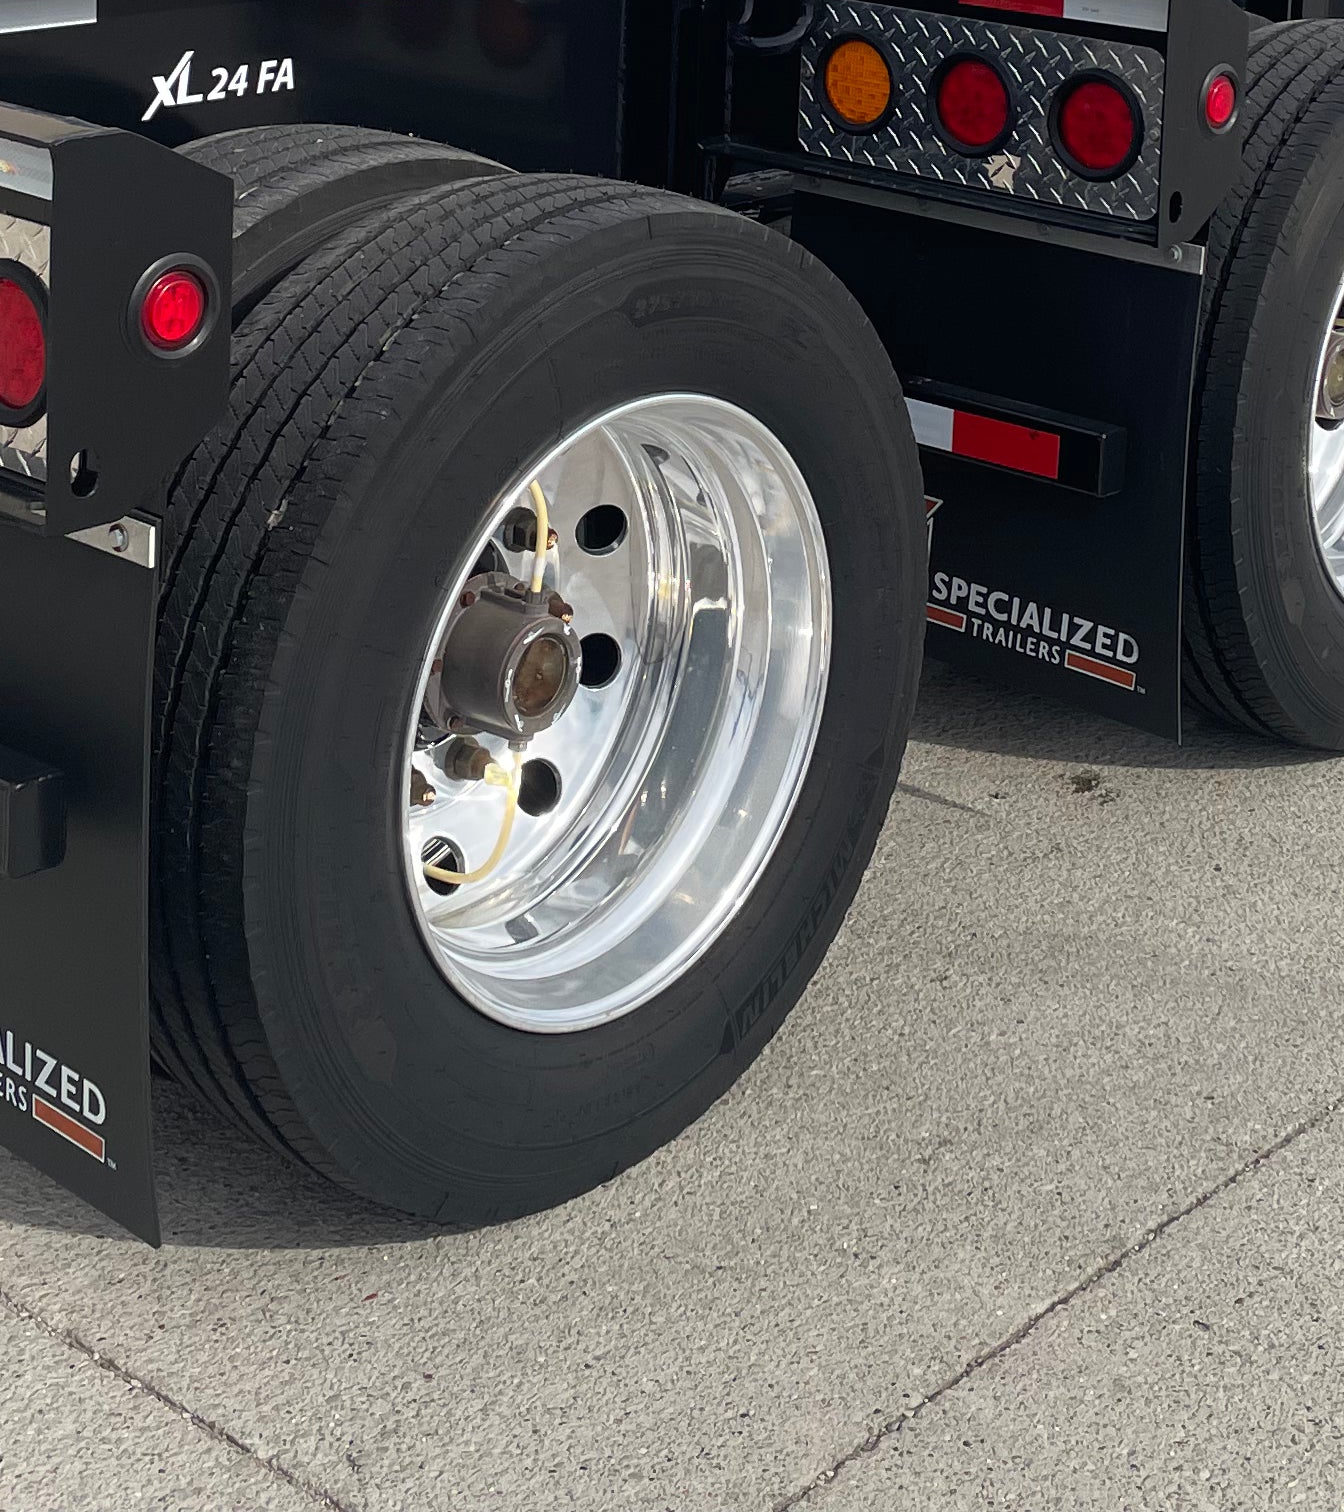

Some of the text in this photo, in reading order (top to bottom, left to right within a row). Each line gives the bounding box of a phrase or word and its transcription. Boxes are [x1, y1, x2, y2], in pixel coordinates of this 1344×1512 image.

[141, 50, 296, 122] XL 24 FA
[931, 571, 1140, 665] SPECIALIZED
[970, 617, 1061, 666] TRAILERS
